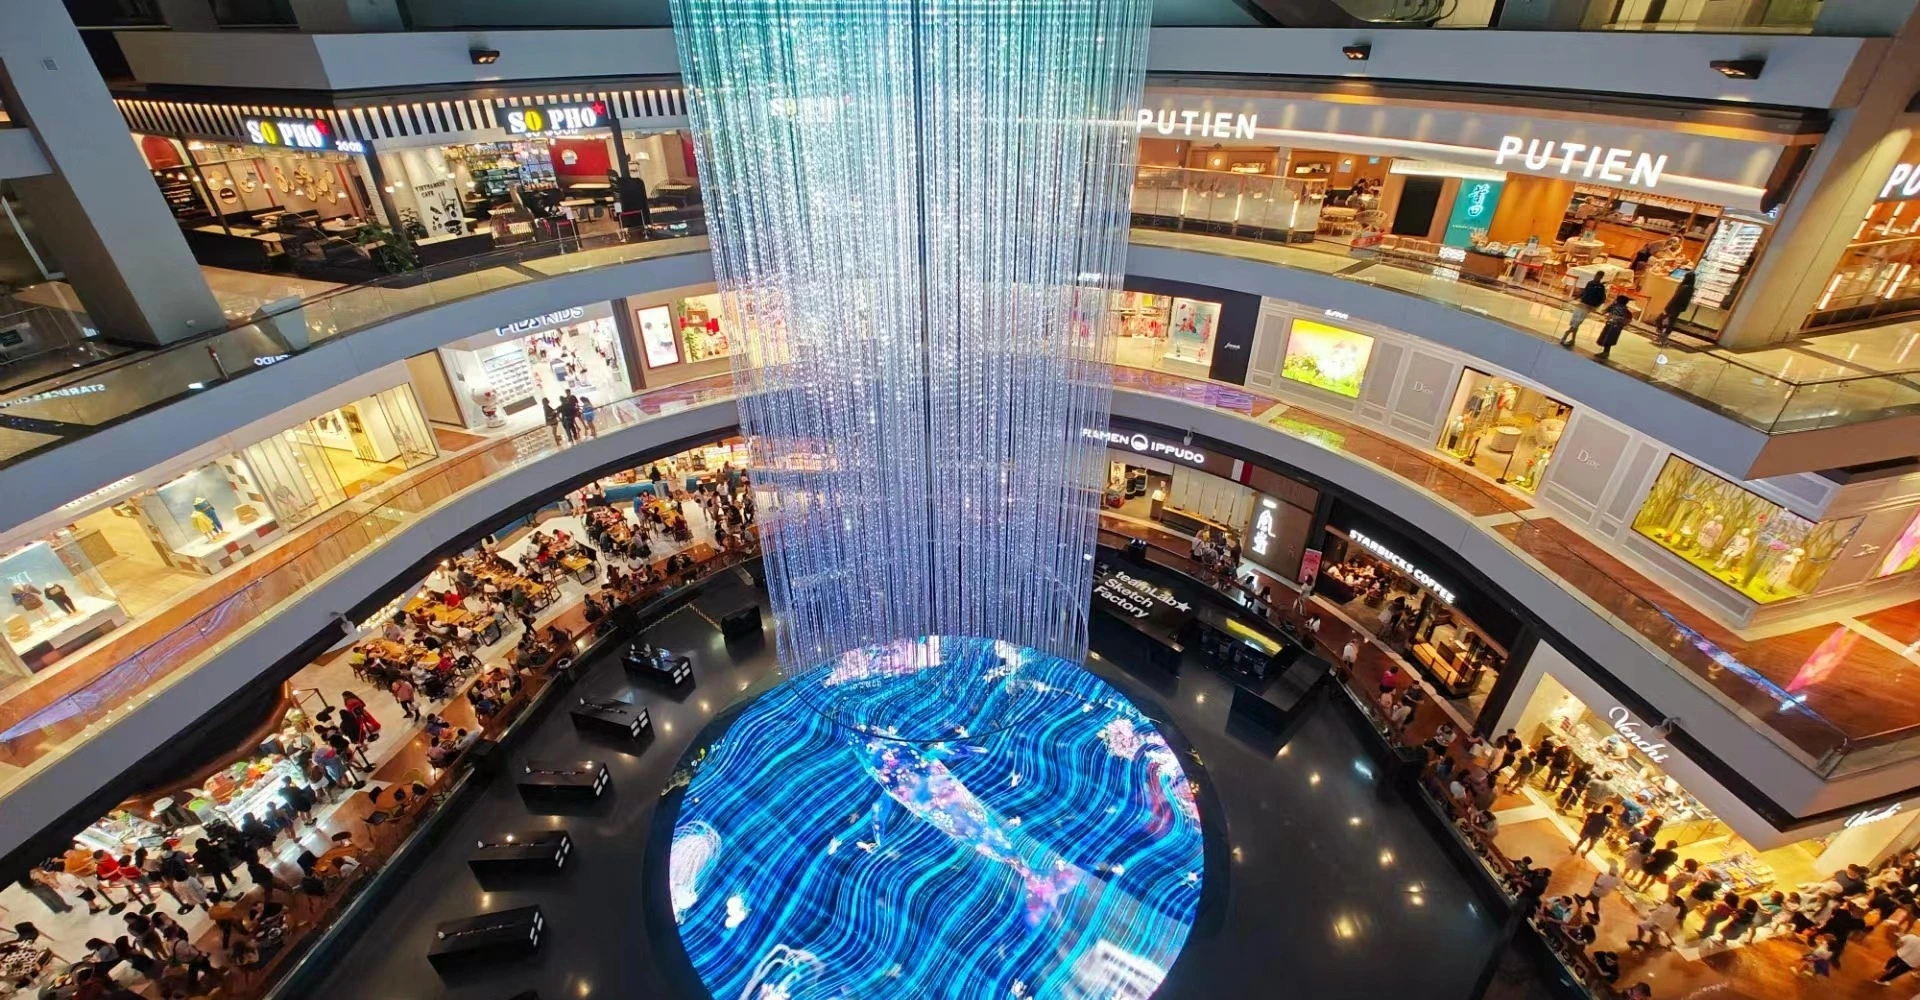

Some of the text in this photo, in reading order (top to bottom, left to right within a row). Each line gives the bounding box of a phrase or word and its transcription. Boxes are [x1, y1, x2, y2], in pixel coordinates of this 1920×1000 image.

[246, 120, 324, 148] SO PHO
[507, 109, 543, 133] SO
[547, 106, 597, 129] PHO
[1136, 108, 1258, 140] PUTIEN
[1495, 135, 1668, 188] PUTIEN
[1151, 441, 1205, 464] IPPUDO
[1349, 529, 1457, 604] STARBUCKS COFFEE
[1093, 585, 1150, 618] Factory
[1105, 578, 1154, 608] Sketch
[1608, 706, 1670, 764] Venchi
